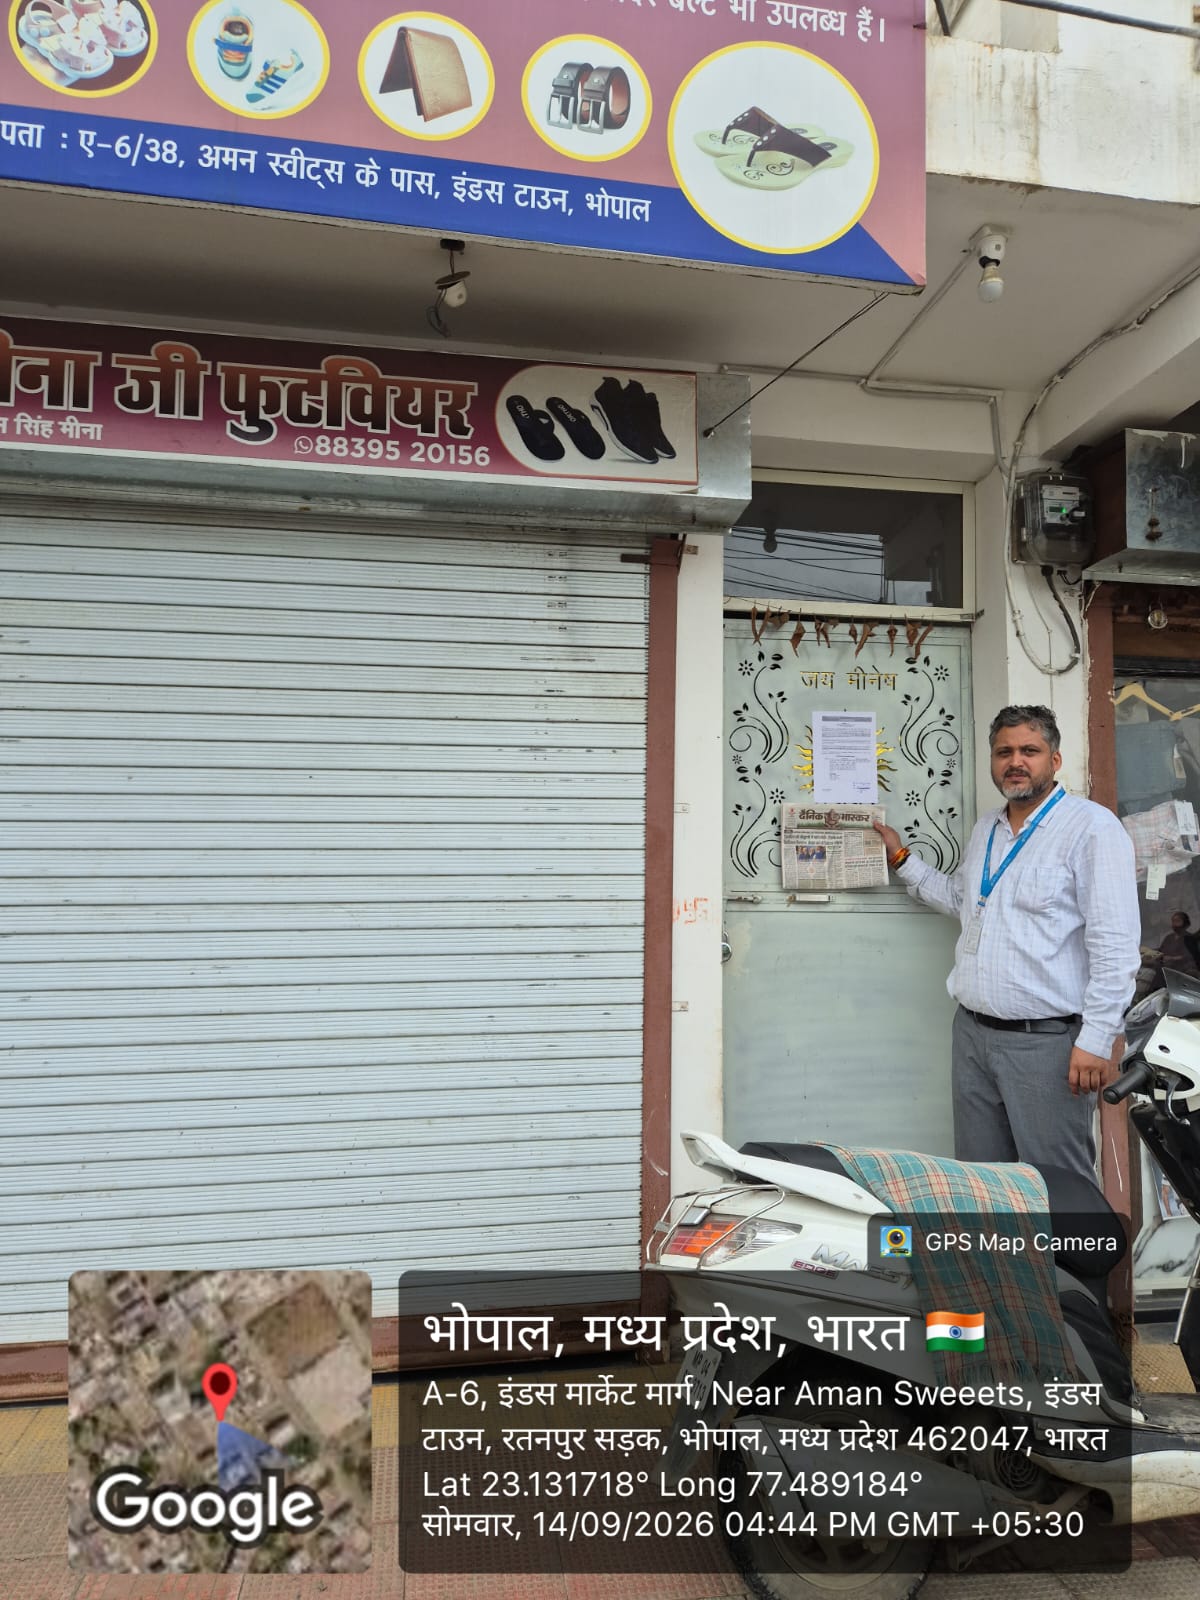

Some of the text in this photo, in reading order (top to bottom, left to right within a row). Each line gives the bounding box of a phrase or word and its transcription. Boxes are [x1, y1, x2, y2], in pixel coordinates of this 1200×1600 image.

[766, 1, 847, 36] उपलब्ध
[0, 120, 45, 149] पता
[198, 145, 258, 174] अमन
[266, 147, 345, 189] स्वीट्स
[355, 157, 381, 188] के
[390, 168, 440, 199] पास,
[451, 171, 505, 205] इंडस
[513, 183, 573, 216] टाउन,
[585, 187, 651, 222] भोपाल
[112, 340, 212, 421] जी
[217, 354, 478, 445] फुटवियर
[14, 412, 54, 438] सिंह
[57, 415, 103, 440] मीना
[315, 435, 491, 467] 88395 20156
[799, 670, 836, 690] जय
[799, 808, 824, 821] दैनिक
[793, 1259, 838, 1279] EDGE
